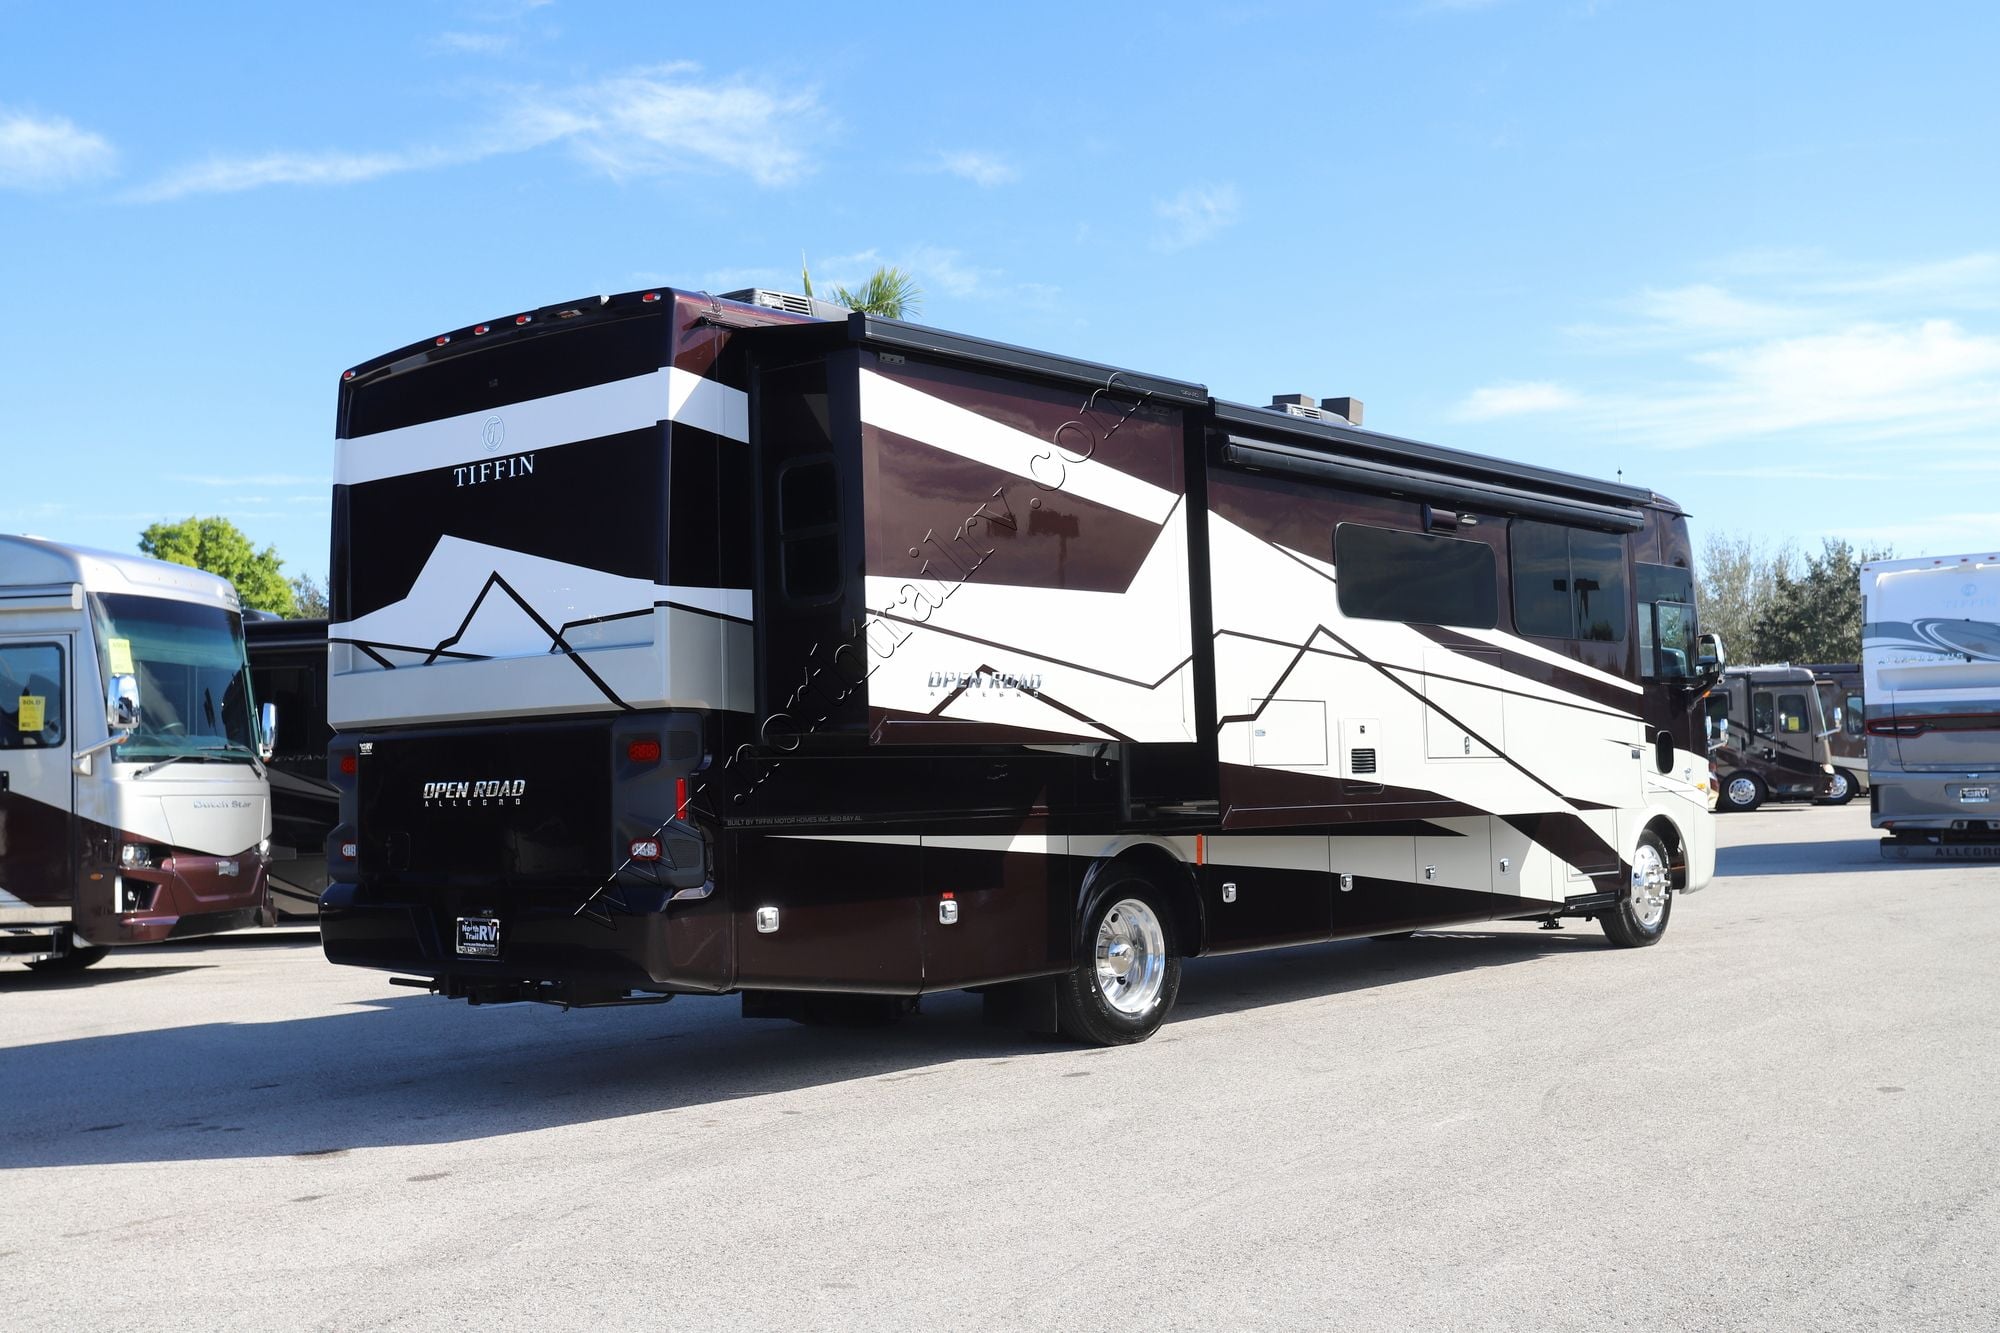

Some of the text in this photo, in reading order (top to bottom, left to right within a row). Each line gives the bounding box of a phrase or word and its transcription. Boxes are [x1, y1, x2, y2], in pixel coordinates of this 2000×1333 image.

[453, 454, 536, 488] TIFFIN
[928, 671, 1042, 689] OPEN ROAD
[423, 779, 526, 799] OPEN ROAD
[424, 798, 521, 807] ALLEGRO
[462, 924, 497, 941] North RV
[465, 932, 479, 940] Trail
